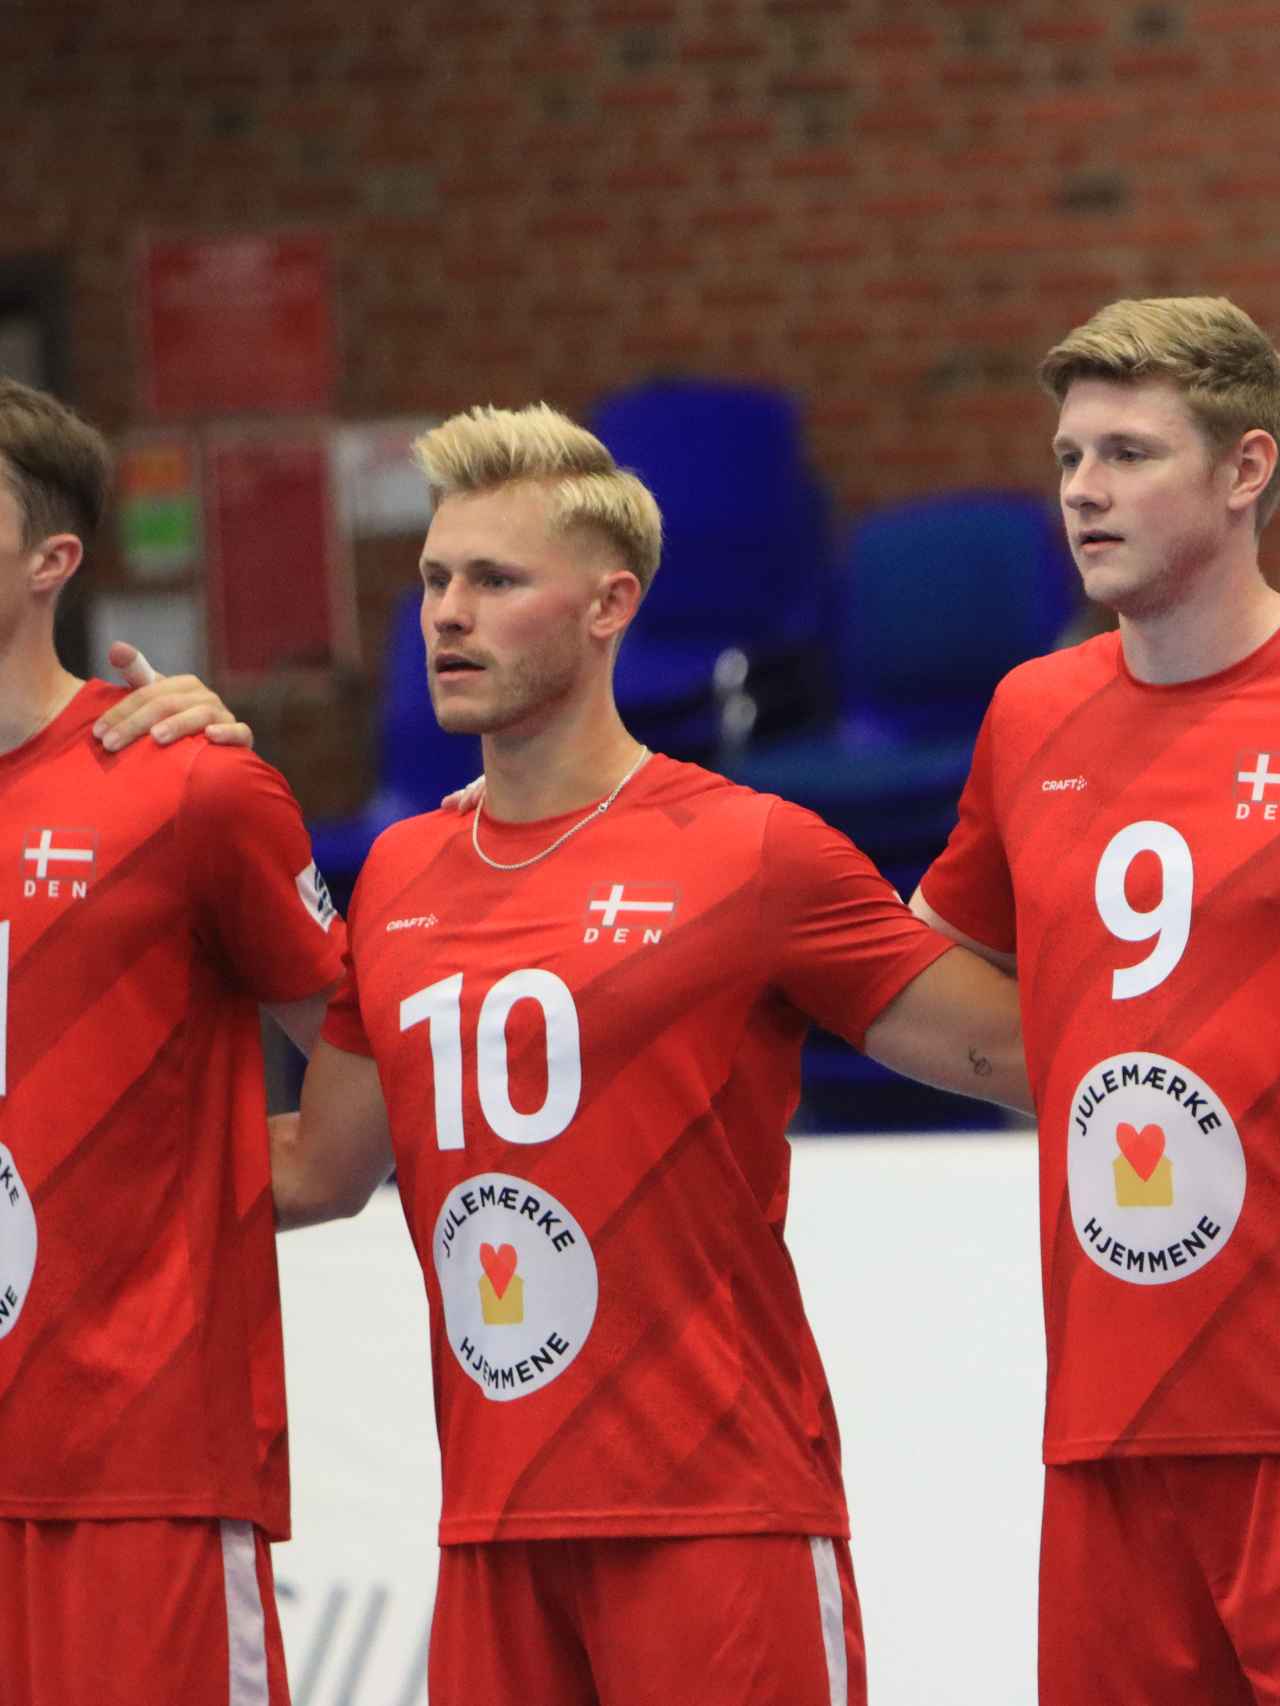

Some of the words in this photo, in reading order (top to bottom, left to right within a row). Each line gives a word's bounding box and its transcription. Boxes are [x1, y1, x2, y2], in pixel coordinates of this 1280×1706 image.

[1041, 778, 1078, 791] CRAFT
[386, 917, 427, 932] CRAFT
[1095, 821, 1194, 1000] 9
[399, 968, 582, 1151] 10
[1075, 1064, 1222, 1136] JULEMÆRKE
[442, 1185, 576, 1258] JULEMÆRKE
[1084, 1215, 1221, 1273] HJEMMENE
[460, 1332, 570, 1390] HJEMMENE
